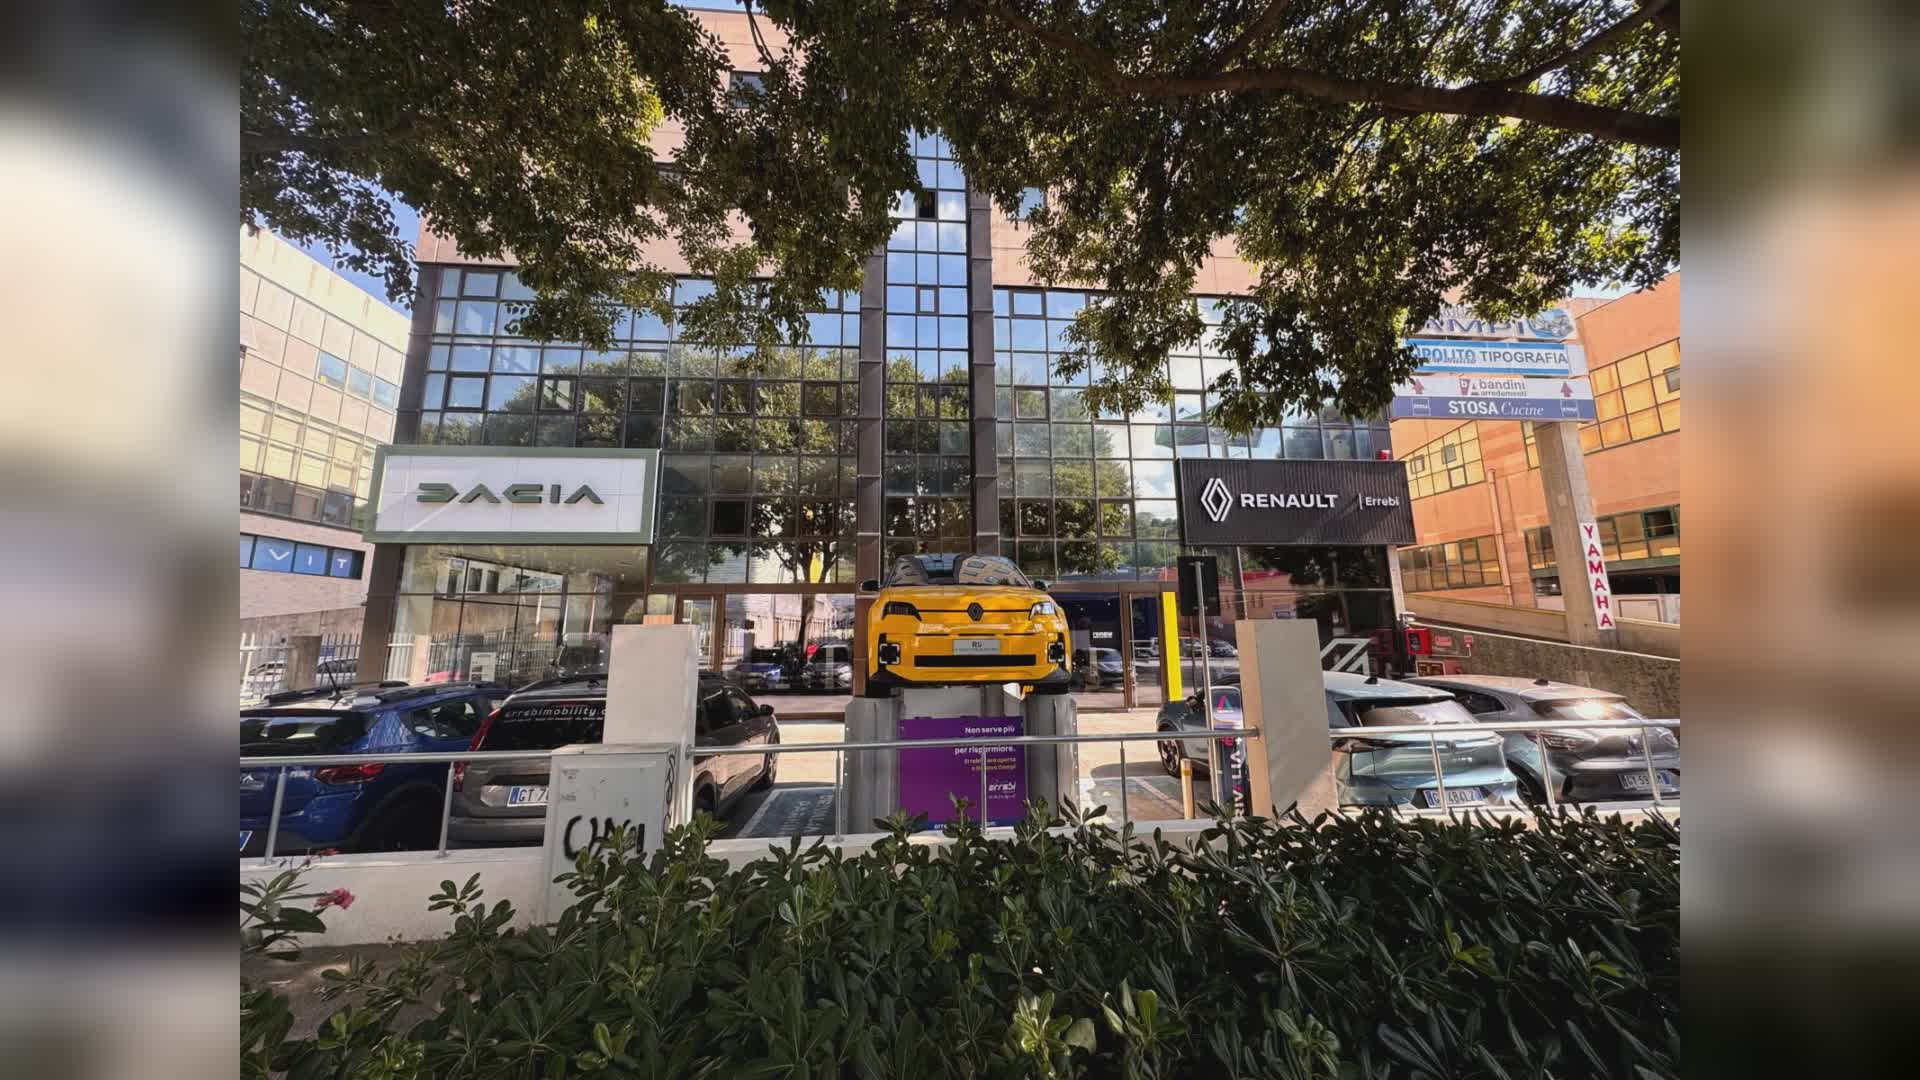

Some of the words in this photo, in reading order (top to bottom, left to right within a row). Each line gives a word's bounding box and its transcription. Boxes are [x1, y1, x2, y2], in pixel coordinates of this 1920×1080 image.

[1479, 350, 1569, 365] TIPOGRAFIA
[1479, 379, 1526, 391] bandini
[1448, 401, 1499, 415] STOSA
[1501, 402, 1544, 416] Cucine
[416, 482, 605, 505] DACIA
[1240, 493, 1339, 509] RENAULT
[1365, 496, 1400, 507] Errebi
[1584, 525, 1613, 627] YAMAHA
[954, 747, 967, 755] per
